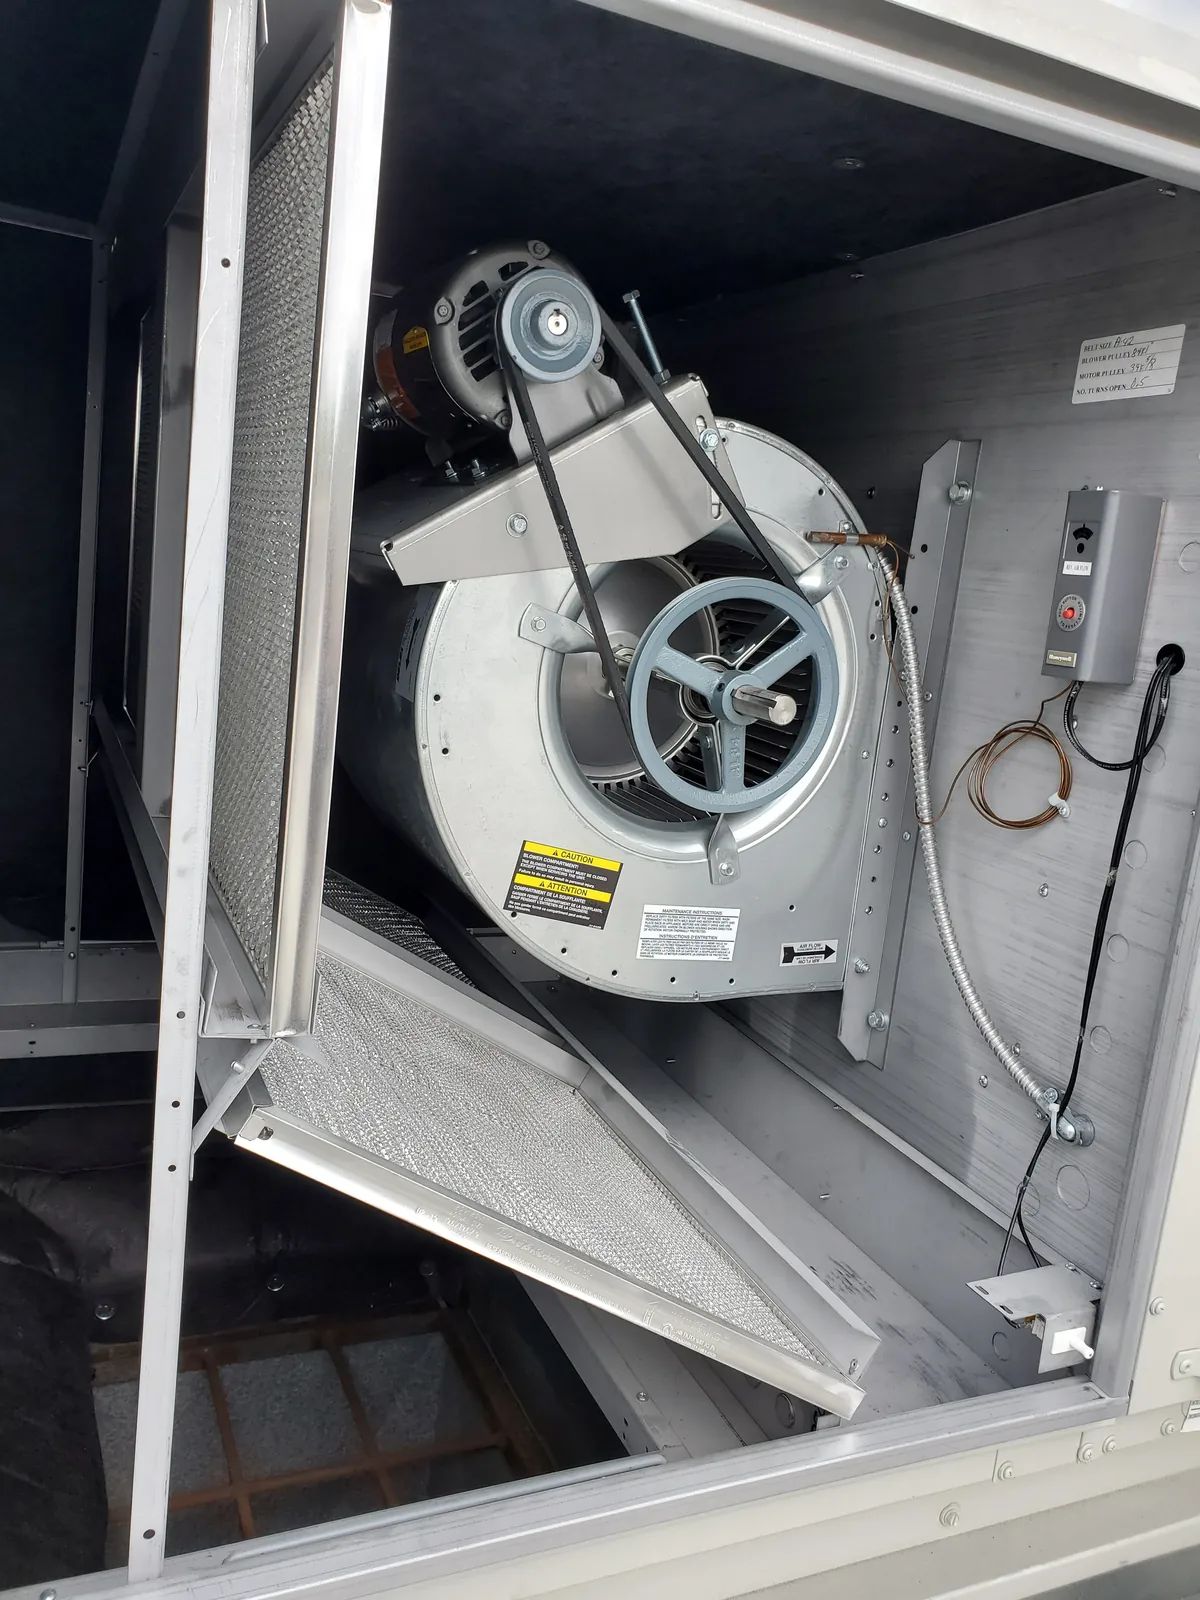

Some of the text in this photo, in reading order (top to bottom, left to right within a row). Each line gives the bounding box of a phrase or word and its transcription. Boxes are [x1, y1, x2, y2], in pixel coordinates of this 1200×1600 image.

[1083, 343, 1101, 352] BELT
[1100, 341, 1112, 350] SIZE
[1081, 354, 1107, 364] BLOWER
[1107, 350, 1131, 361] PULLEY
[1079, 370, 1101, 380] MOTOR
[1101, 367, 1125, 377] PULLEY
[1076, 387, 1087, 396] NO.
[1088, 384, 1108, 393] TURNS
[1109, 382, 1127, 391] OPEN
[1048, 653, 1072, 662] Honeywell
[522, 852, 543, 861] BLOWER
[560, 851, 593, 864] CAUTION
[546, 864, 575, 874] COMPARTMENT
[546, 881, 588, 896] ATTENTION
